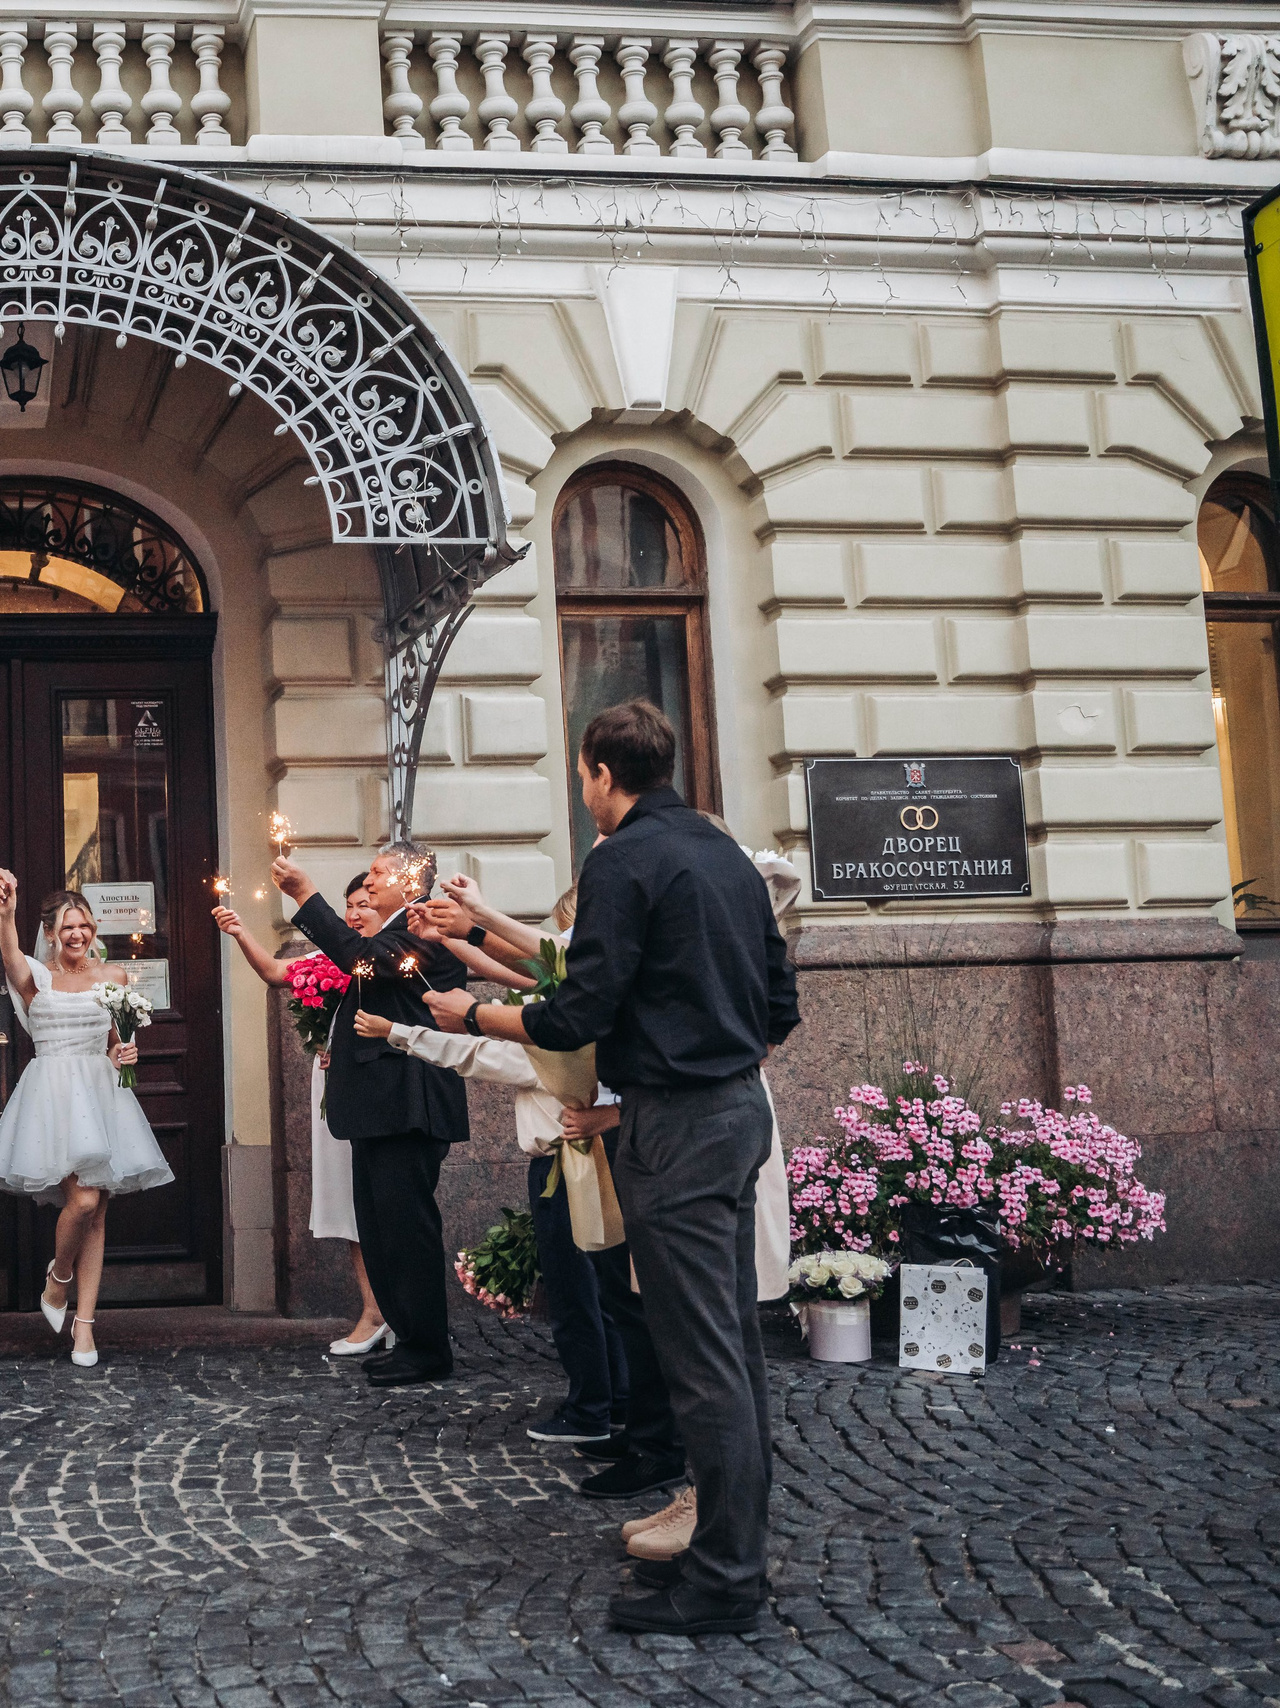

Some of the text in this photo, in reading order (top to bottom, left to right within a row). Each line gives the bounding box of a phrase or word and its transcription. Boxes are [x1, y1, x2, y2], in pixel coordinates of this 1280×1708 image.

[882, 836, 962, 856] ДВОРЕЦ
[831, 859, 1013, 879] БРАКОСОЧЕТАНИЯ
[953, 880, 965, 889] 52
